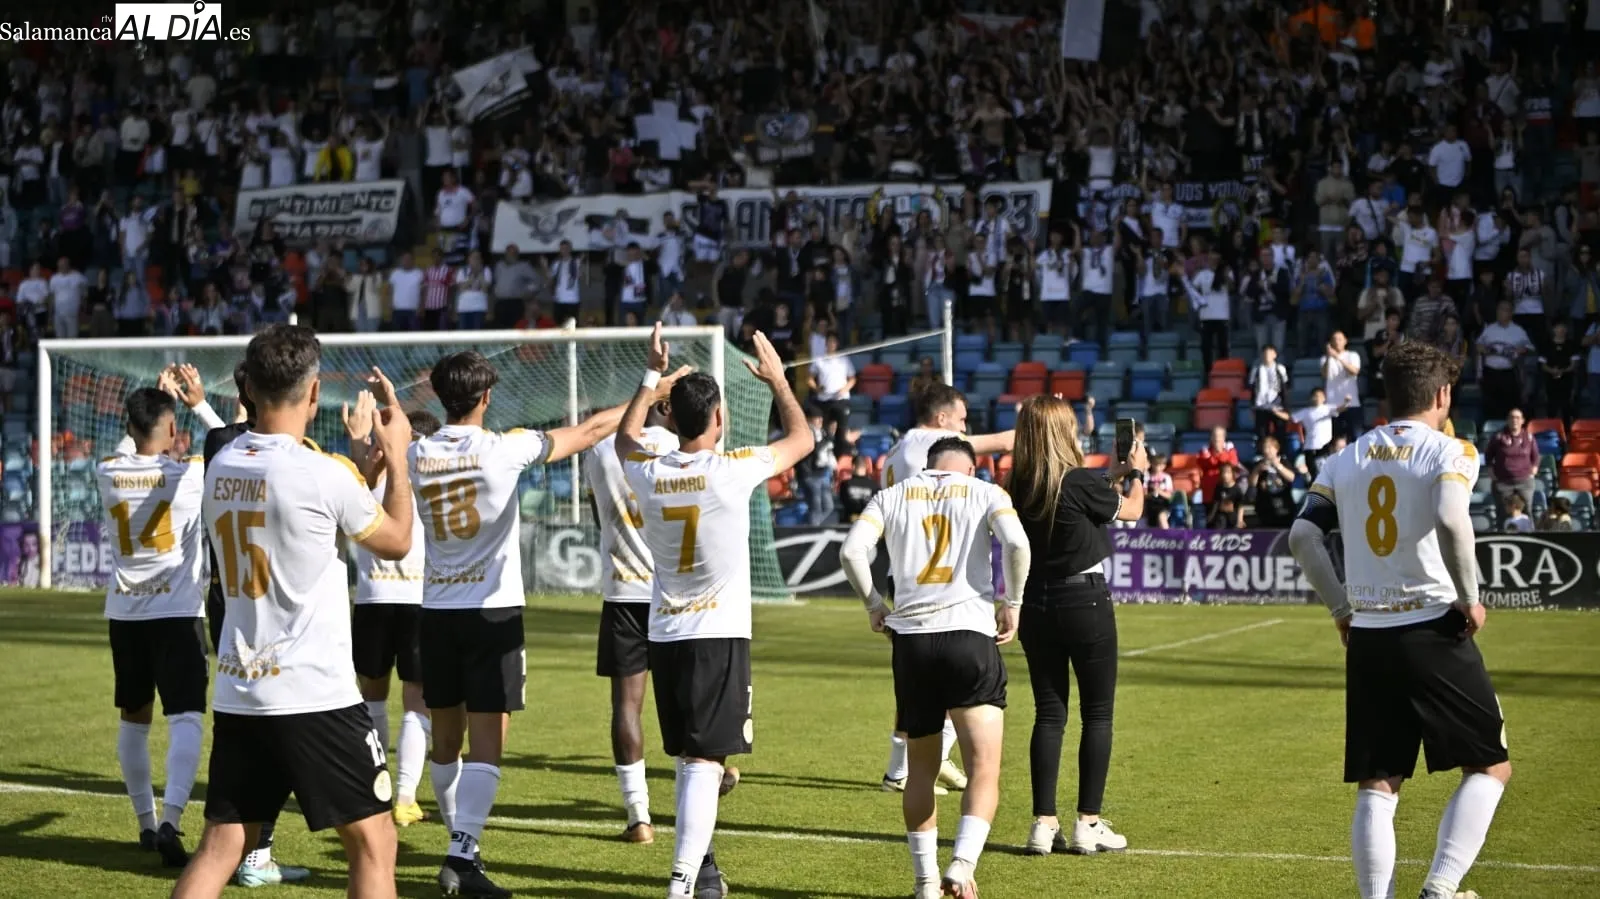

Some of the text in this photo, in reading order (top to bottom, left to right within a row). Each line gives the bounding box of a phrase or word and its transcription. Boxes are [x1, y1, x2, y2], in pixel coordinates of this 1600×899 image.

[113, 474, 166, 489] GUSTAVO
[214, 477, 267, 501] ESPINA
[419, 478, 481, 541] 18
[654, 475, 706, 494] ALVARO
[109, 499, 175, 557] 14
[661, 504, 701, 573] 7
[1113, 532, 1252, 551] Hablemos de UDS
[1366, 475, 1397, 557] 8
[52, 542, 112, 574] FEDE
[215, 510, 270, 600] 15
[917, 514, 953, 585] 2
